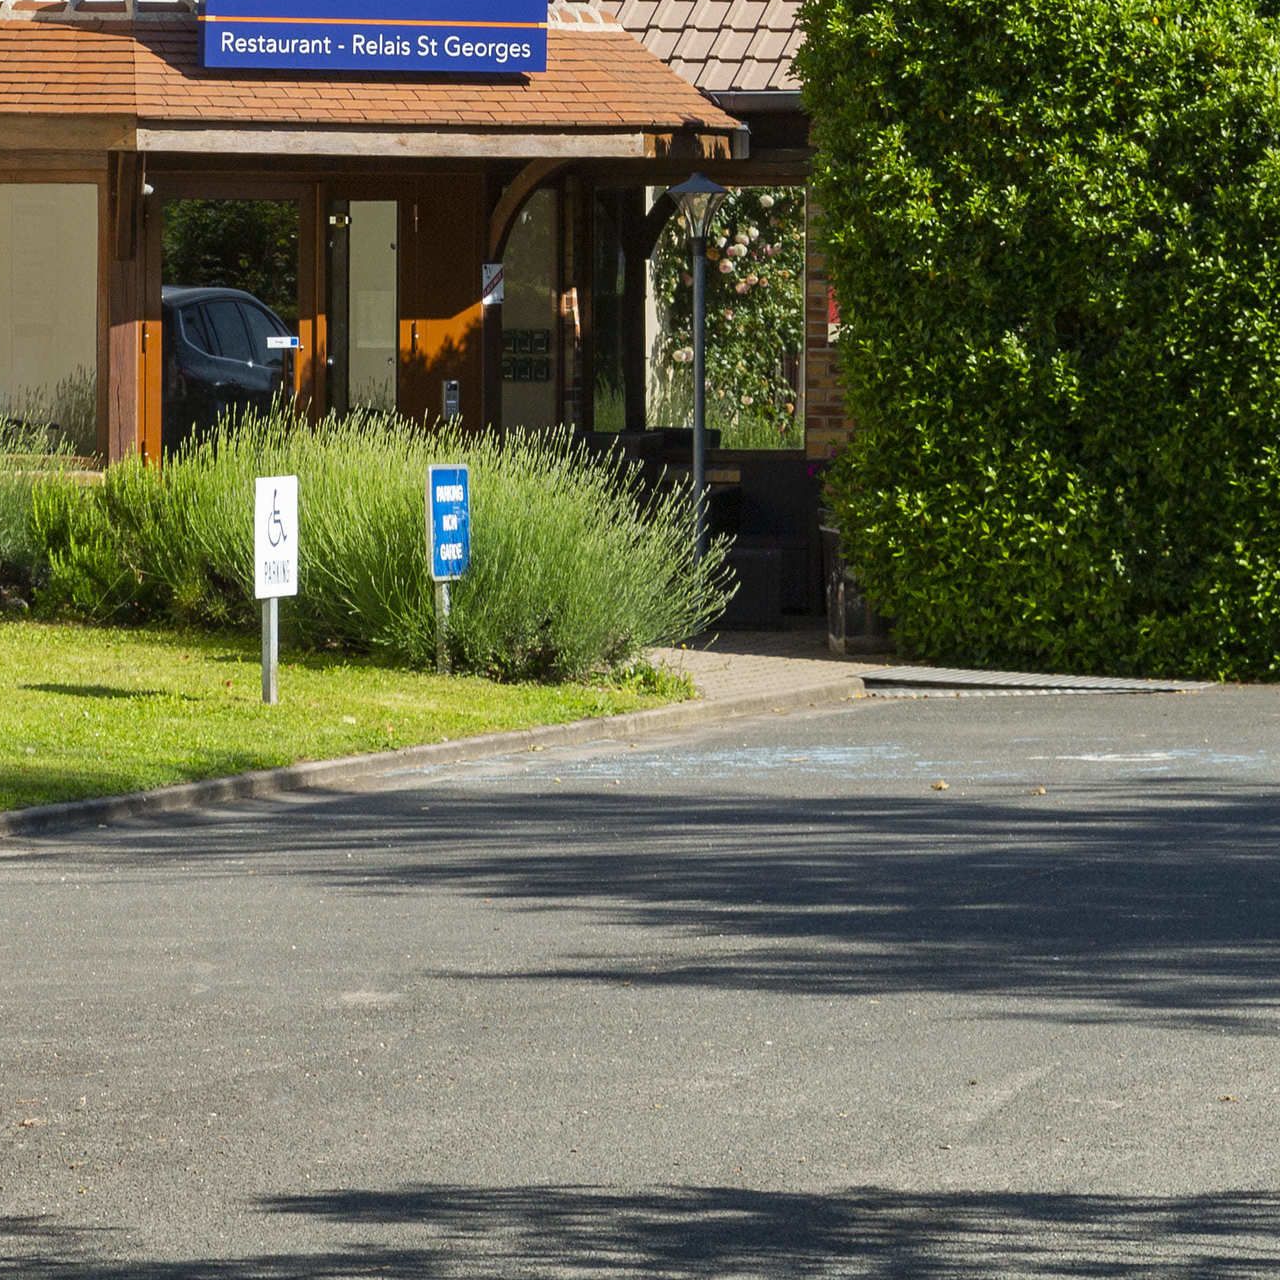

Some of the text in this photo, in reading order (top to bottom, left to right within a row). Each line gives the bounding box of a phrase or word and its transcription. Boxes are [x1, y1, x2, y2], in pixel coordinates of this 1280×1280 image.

[221, 31, 332, 55] Restaurant
[352, 33, 411, 56] Relais
[417, 34, 438, 57] St
[444, 35, 531, 64] Georges
[436, 485, 463, 503] PARKING
[264, 560, 290, 584] PARKING
